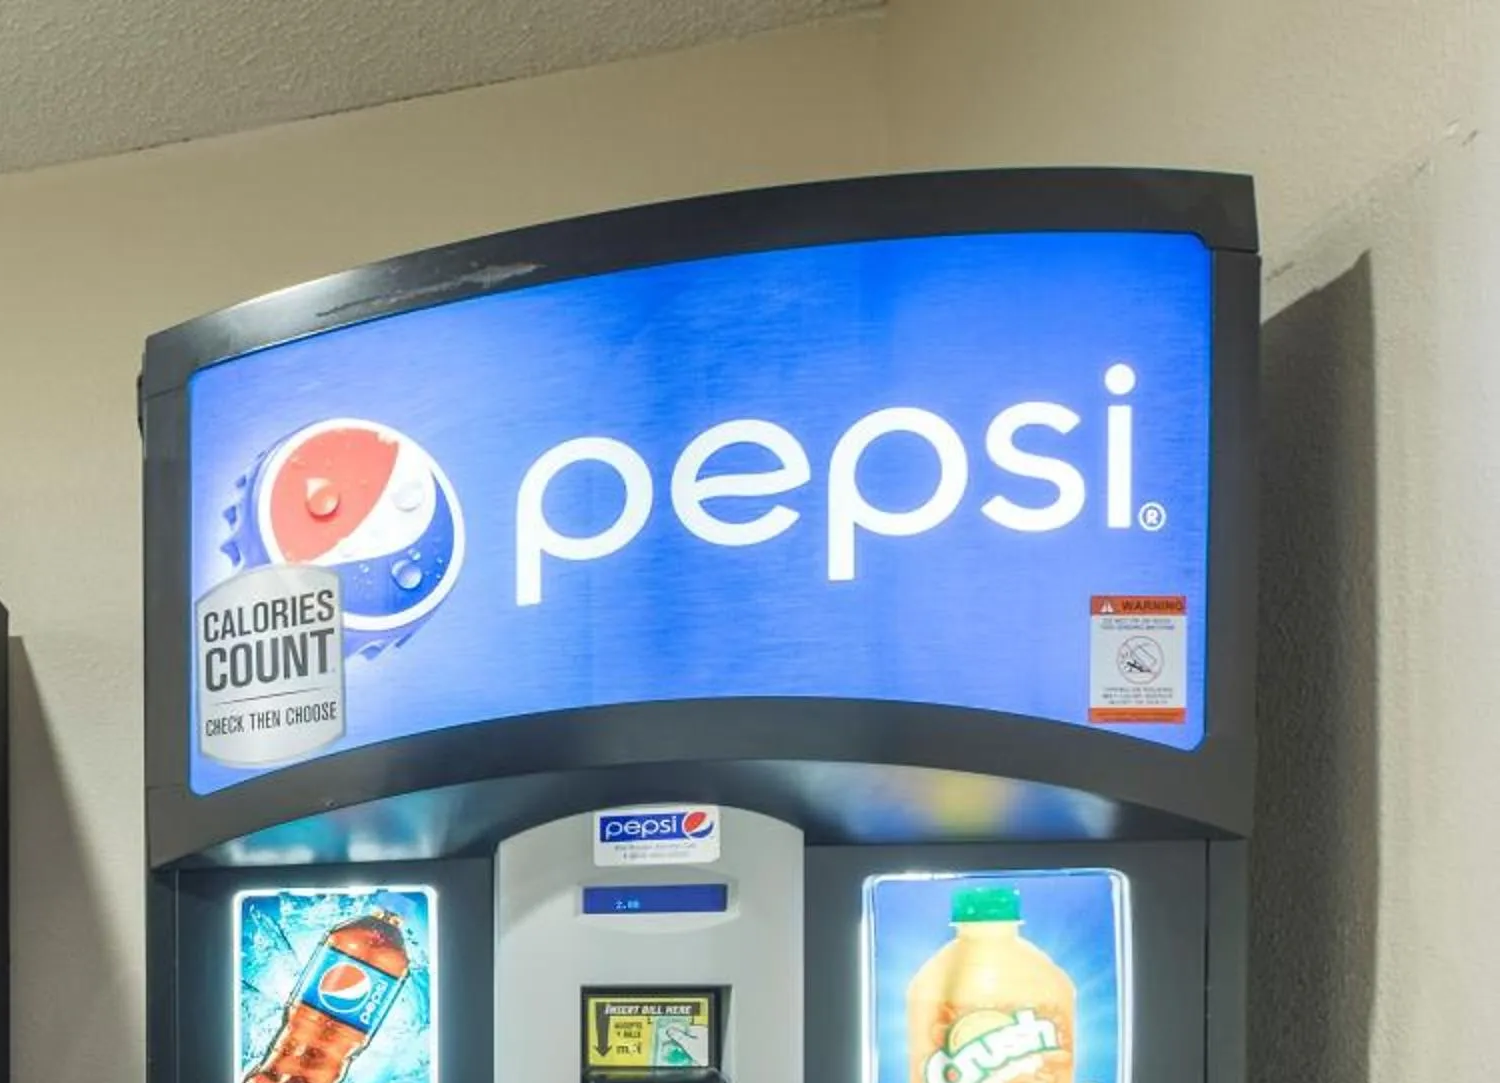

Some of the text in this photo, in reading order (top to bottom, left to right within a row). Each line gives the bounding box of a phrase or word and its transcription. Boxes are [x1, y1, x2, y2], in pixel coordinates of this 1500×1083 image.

[516, 364, 1136, 607] pepsi
[203, 589, 334, 643] CALORIES
[204, 628, 335, 692] COUNT
[205, 702, 337, 738] CHECK THEN CHOOSE
[605, 816, 677, 841] pepsi
[359, 981, 389, 1025] pepsi
